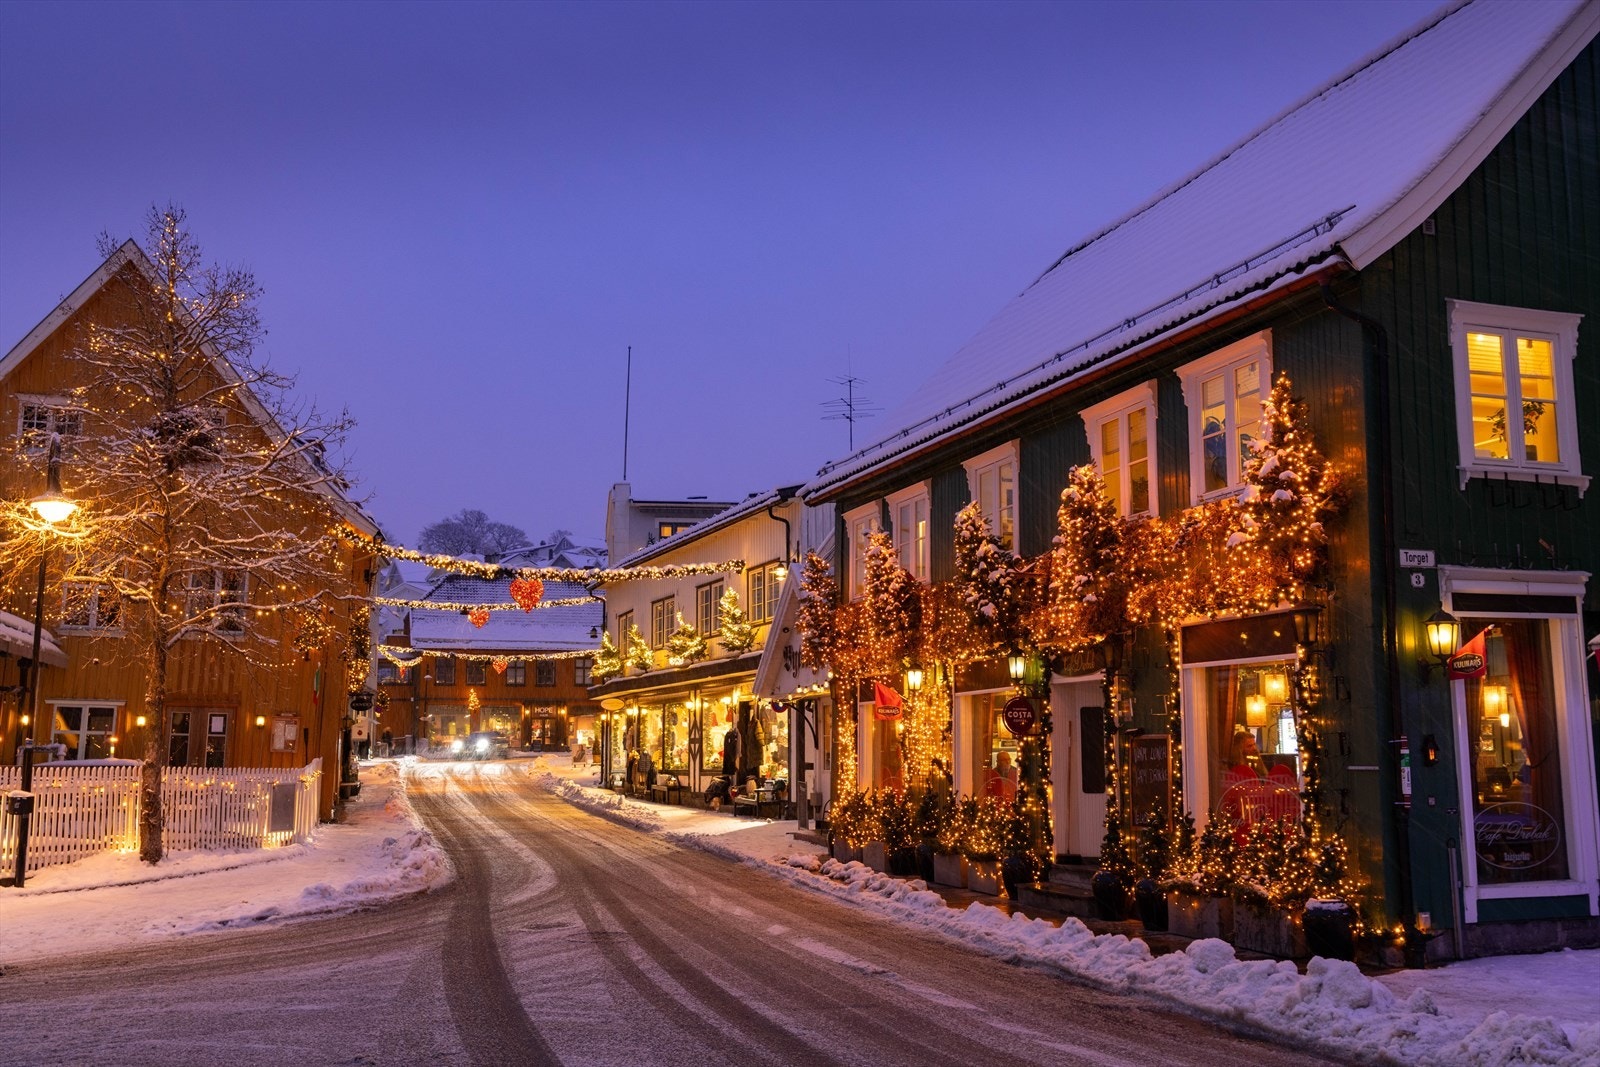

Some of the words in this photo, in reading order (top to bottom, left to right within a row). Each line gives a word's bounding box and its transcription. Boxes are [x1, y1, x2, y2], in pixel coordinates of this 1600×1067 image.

[1403, 551, 1429, 566] Torget
[1414, 574, 1422, 586] 3
[1007, 710, 1032, 719] COSTA
